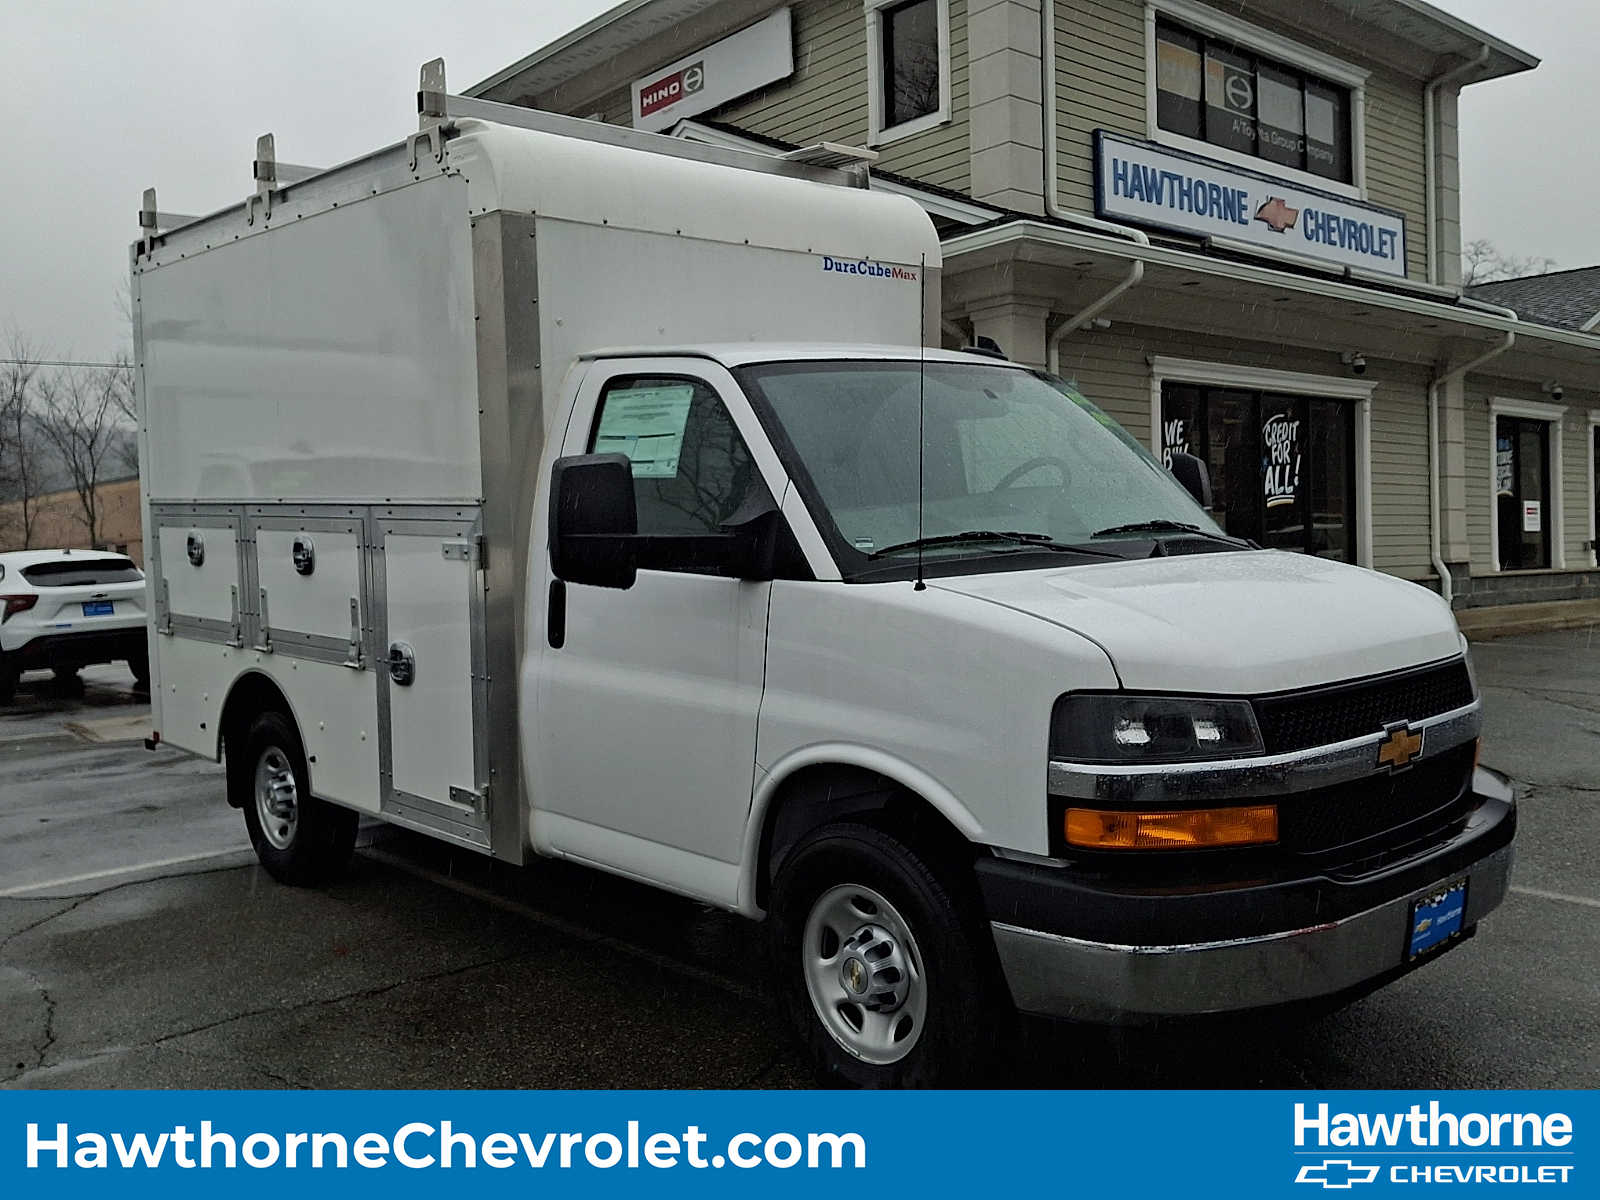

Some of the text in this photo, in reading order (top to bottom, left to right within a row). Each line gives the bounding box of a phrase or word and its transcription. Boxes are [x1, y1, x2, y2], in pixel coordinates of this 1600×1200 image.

[642, 82, 680, 107] HINO
[1297, 140, 1334, 164] Cmpany
[1113, 158, 1397, 260] HAWTHORNE CHEVROLET
[824, 257, 917, 280] DuraCubeMax
[1164, 418, 1184, 446] WE
[1263, 420, 1300, 447] CREDIT
[1272, 441, 1291, 465] FOR
[1265, 454, 1301, 495] ALL!
